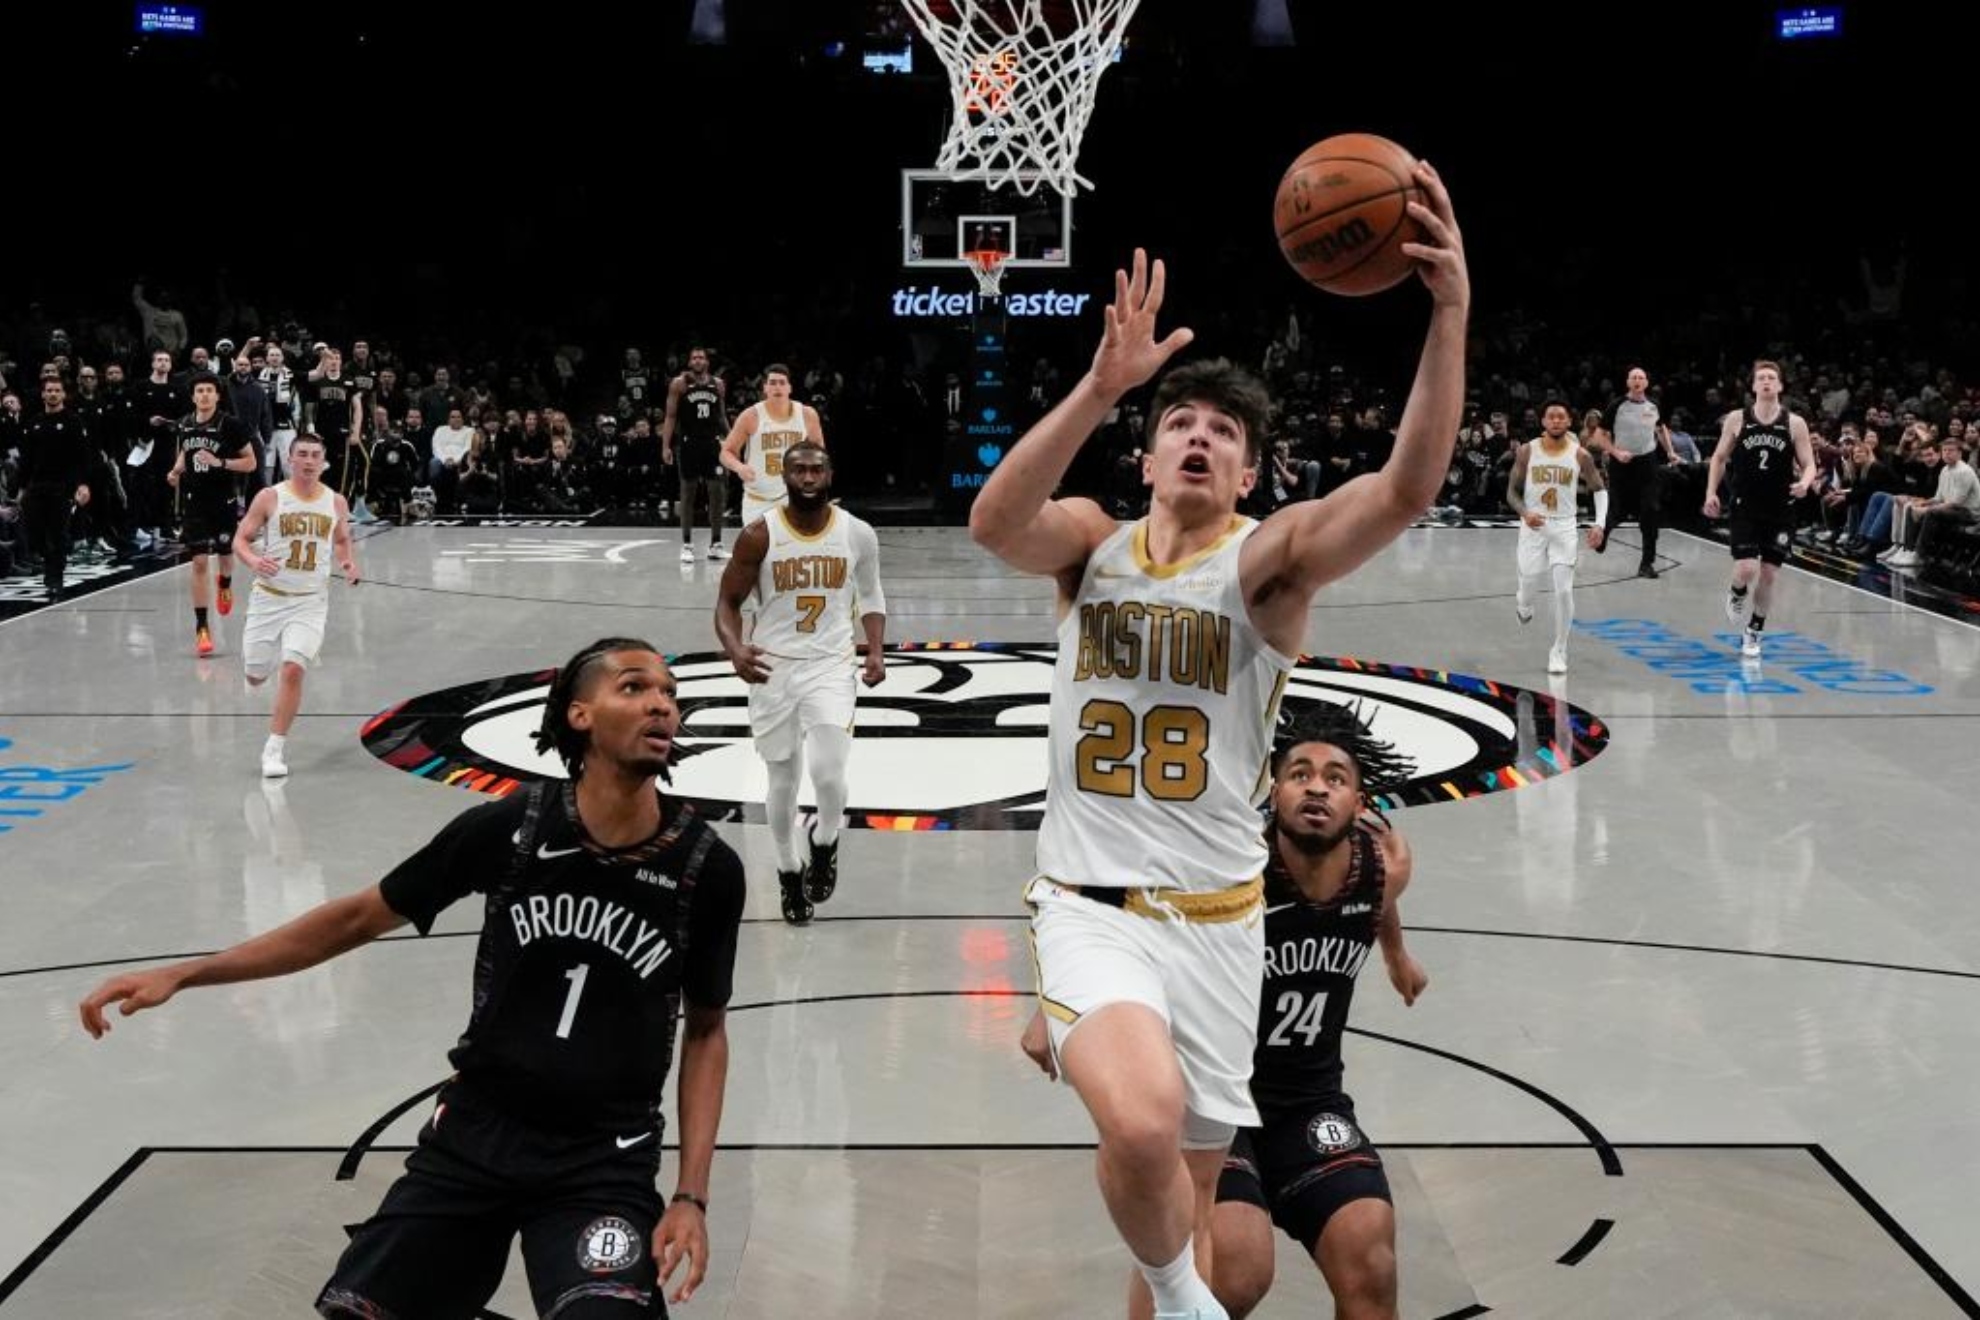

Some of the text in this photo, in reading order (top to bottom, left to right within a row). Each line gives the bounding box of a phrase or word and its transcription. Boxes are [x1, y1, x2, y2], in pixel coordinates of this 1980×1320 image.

[892, 286, 1090, 316] ticketaster
[1743, 433, 1786, 452] BROOKLYN
[1759, 450, 1769, 470] 2
[1541, 487, 1558, 511] 4
[279, 511, 333, 540] BOSTON
[285, 540, 317, 571] 11
[772, 555, 848, 592] BOSTON
[796, 595, 826, 633] 7
[1073, 601, 1231, 695] BOSTON
[1075, 698, 1210, 802] 28
[510, 893, 673, 979] BROOKLYN
[1264, 936, 1371, 979] ROOKLYN
[556, 963, 590, 1039] 1
[1266, 990, 1329, 1046] 24
[1326, 1124, 1341, 1142] B
[601, 1232, 615, 1257] B
